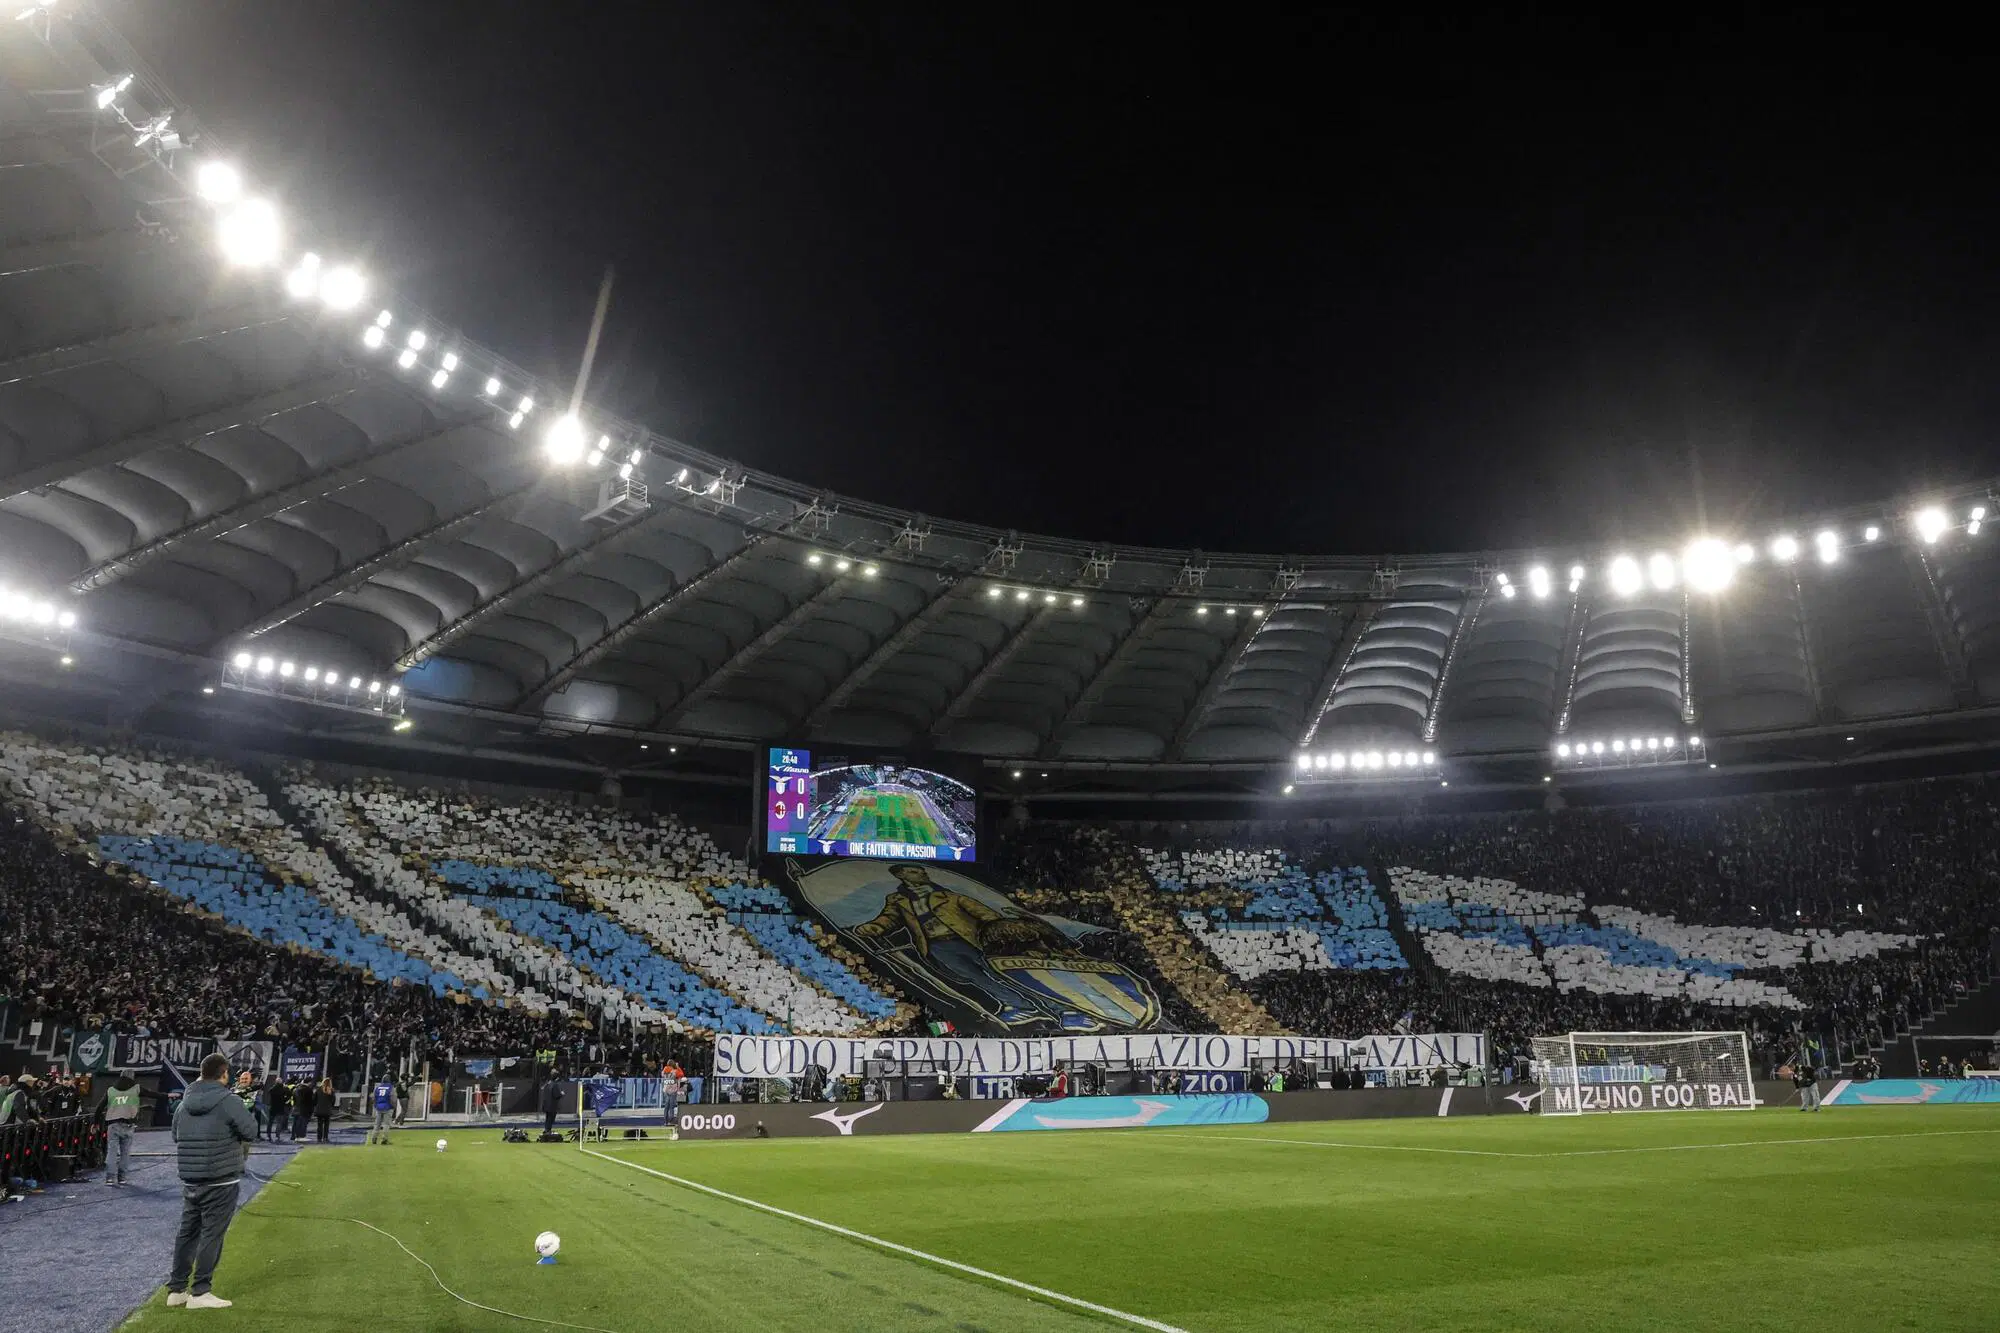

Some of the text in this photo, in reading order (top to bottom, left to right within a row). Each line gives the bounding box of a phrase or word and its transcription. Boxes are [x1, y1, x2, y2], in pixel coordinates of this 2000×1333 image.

[797, 778, 804, 794] 0
[797, 802, 804, 819] 0
[849, 842, 936, 858] ONE FAITH, ONE PASSION
[1001, 959, 1112, 971] CURVA NORD
[717, 1035, 836, 1075] SCUDO
[848, 1040, 866, 1075] E
[878, 1039, 989, 1075] SPADA
[998, 1038, 1112, 1073] DELLA
[1123, 1035, 1230, 1068] LAZIO
[1184, 1073, 1228, 1093] ZIO
[116, 1096, 128, 1104] TV
[1554, 1083, 1764, 1110] MZUNO FOOBALL
[680, 1114, 736, 1130] 00:00
